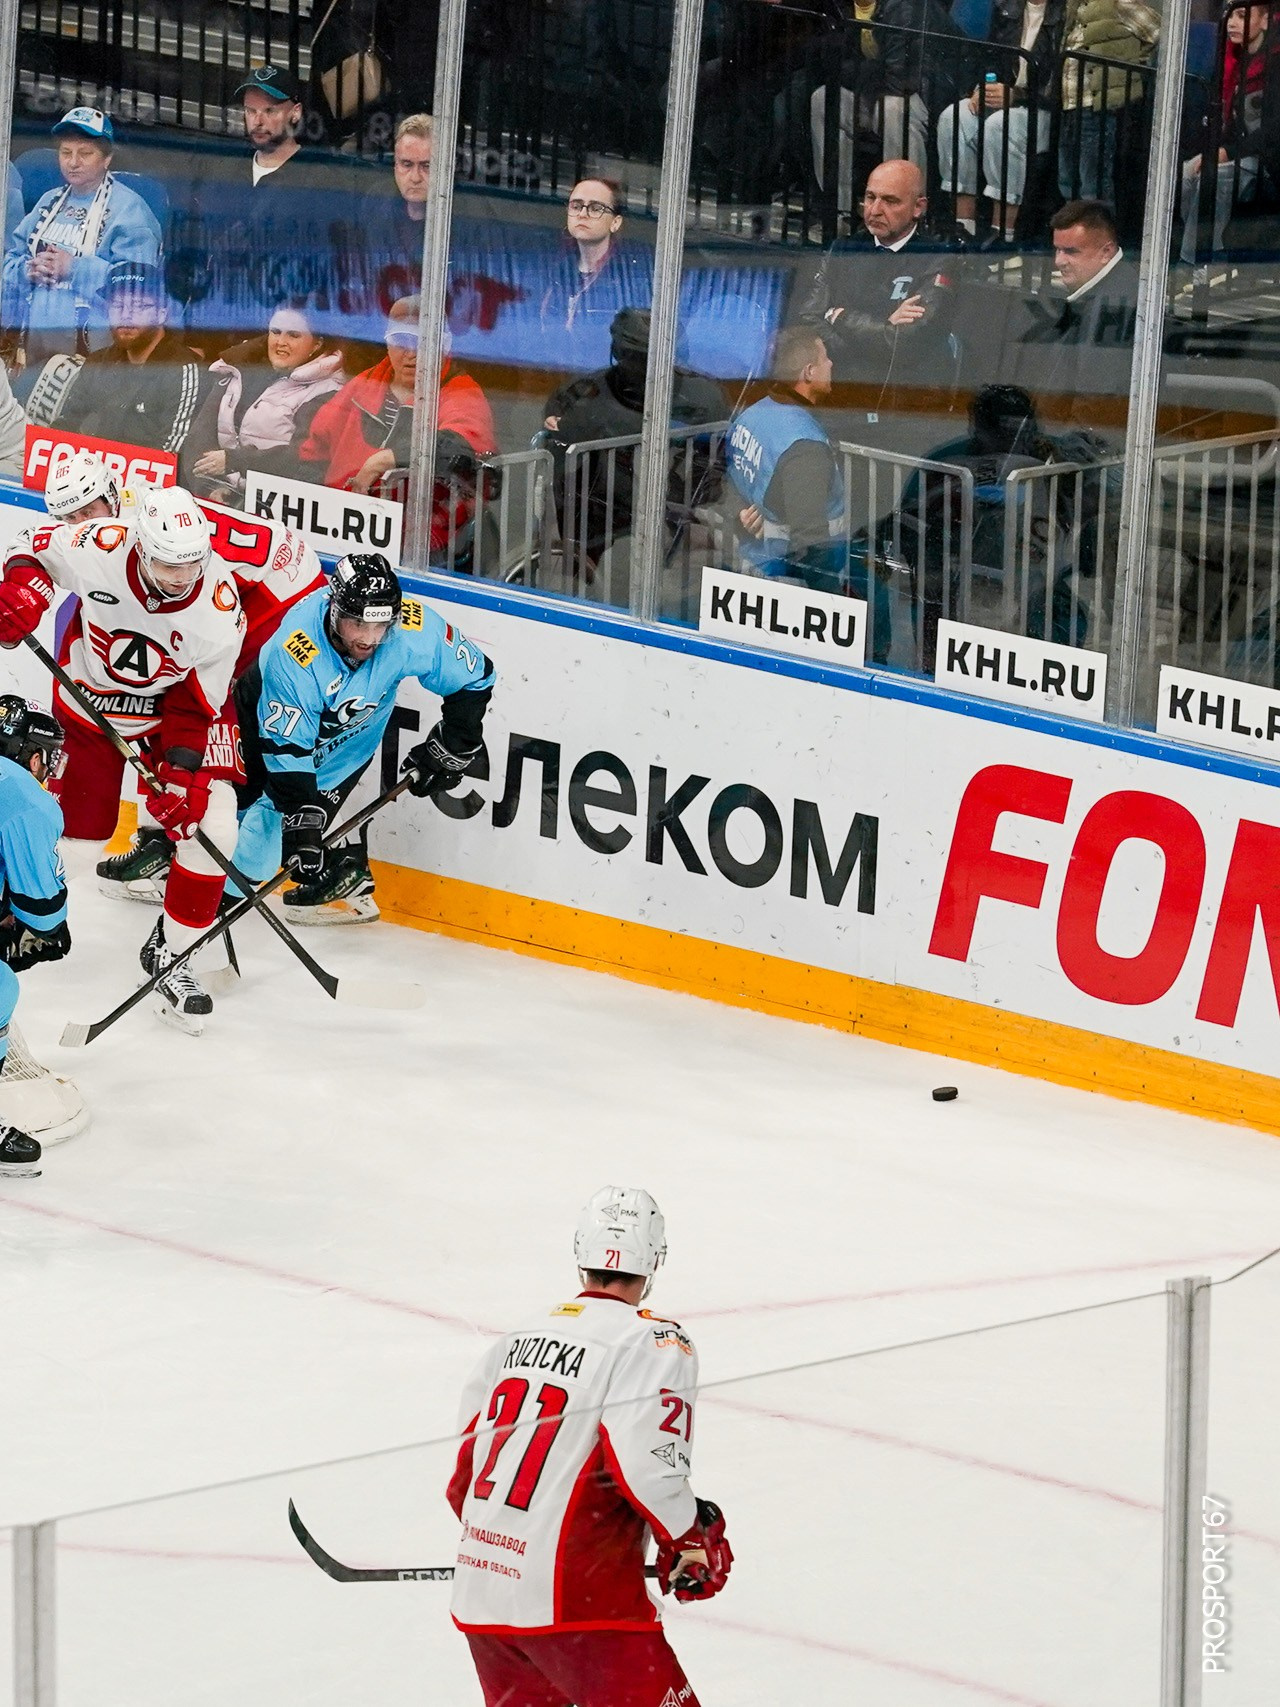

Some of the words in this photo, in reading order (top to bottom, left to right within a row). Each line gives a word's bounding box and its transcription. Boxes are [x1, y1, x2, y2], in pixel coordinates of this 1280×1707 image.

[26, 439, 175, 488] FOBET
[174, 513, 192, 528] 78
[255, 488, 392, 548] KHL.RU
[369, 577, 386, 590] 27
[402, 602, 412, 626] MAX
[412, 602, 422, 626] LINE
[710, 585, 856, 649] KHL.RU
[287, 641, 309, 664] LINE
[293, 632, 317, 653] MAX
[947, 638, 1096, 702] KHL.RU
[264, 700, 303, 737] 27
[139, 857, 162, 875] CCM
[605, 1249, 621, 1270] 21
[503, 1336, 587, 1379] RUZICKA
[659, 1388, 693, 1443] 21
[473, 1377, 569, 1513] 21
[398, 1570, 453, 1581] CCM
